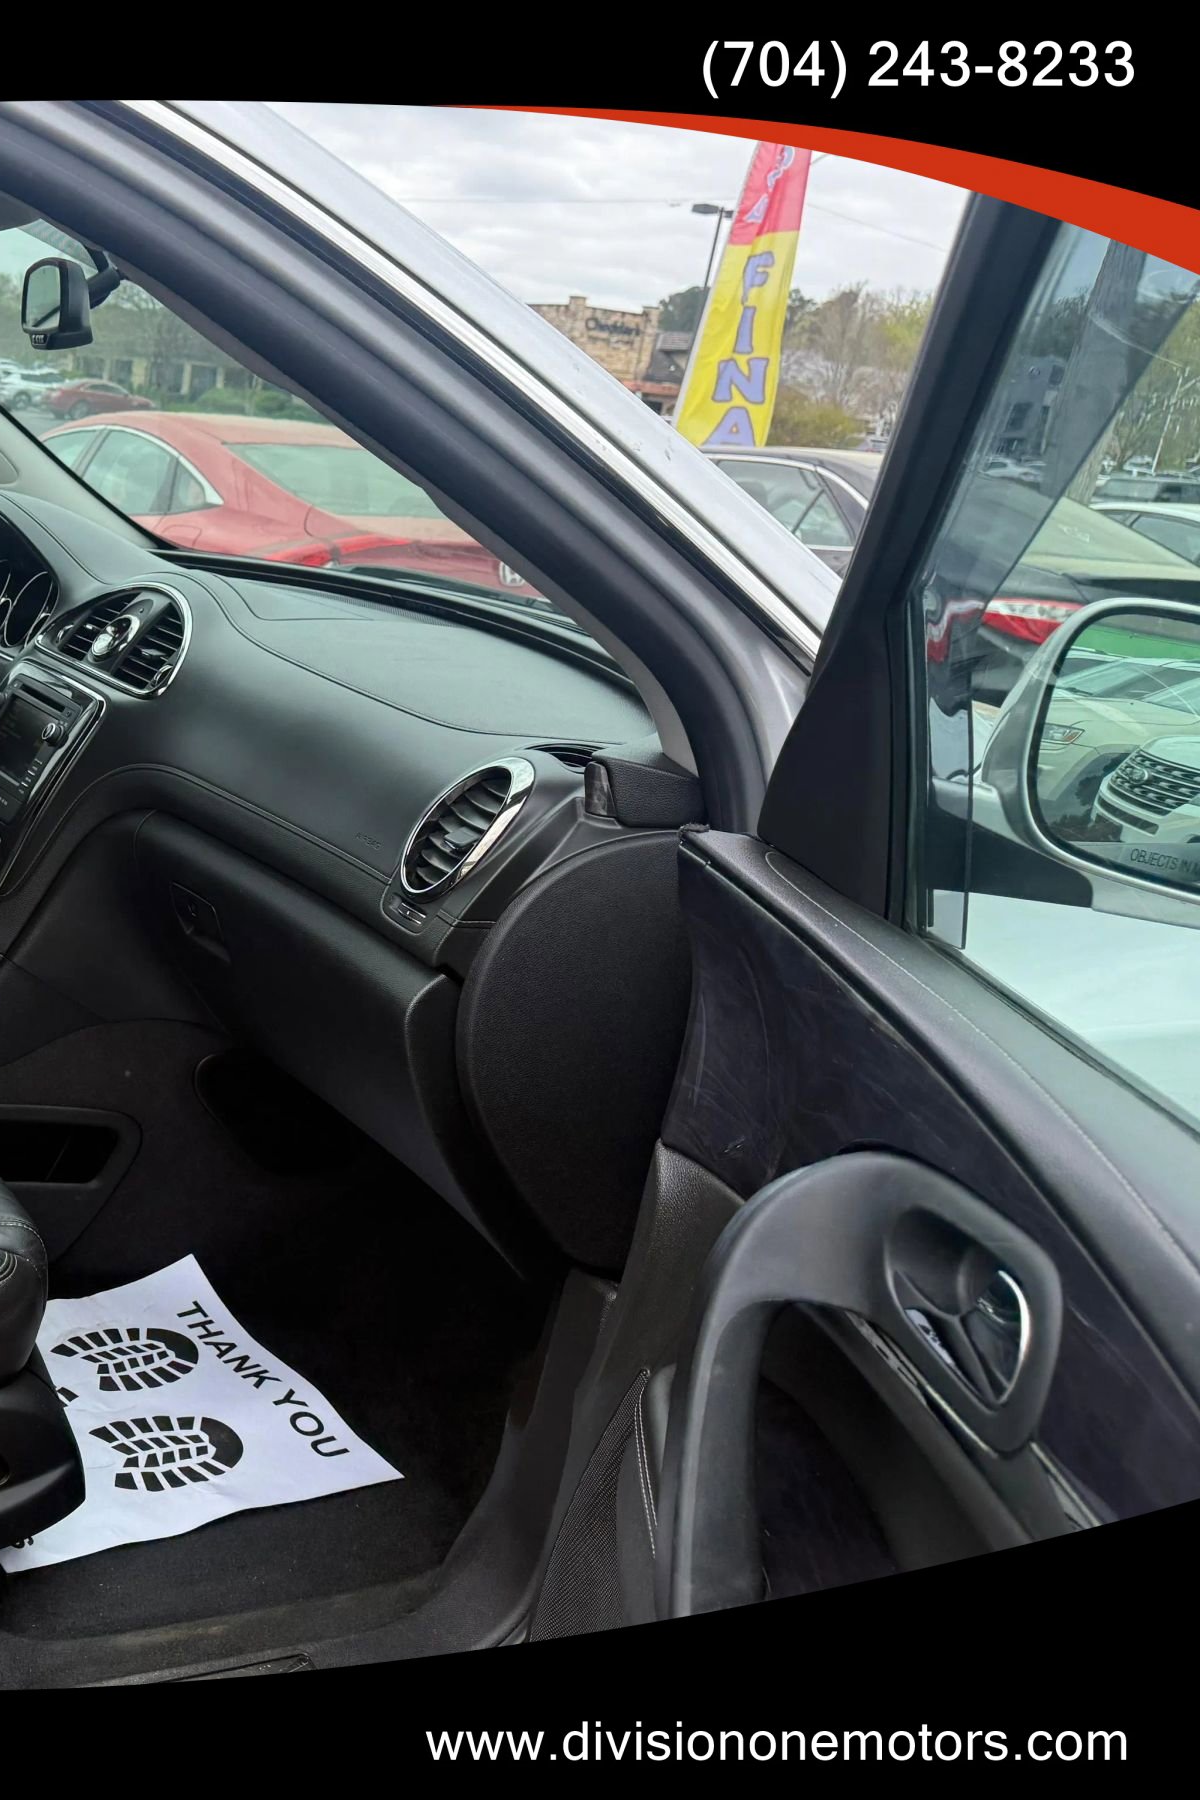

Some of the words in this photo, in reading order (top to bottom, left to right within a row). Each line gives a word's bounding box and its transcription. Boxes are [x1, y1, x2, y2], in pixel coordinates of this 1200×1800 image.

[1130, 848, 1179, 870] OBJECTS
[176, 1300, 283, 1389] THANK
[272, 1388, 350, 1457] YOU
